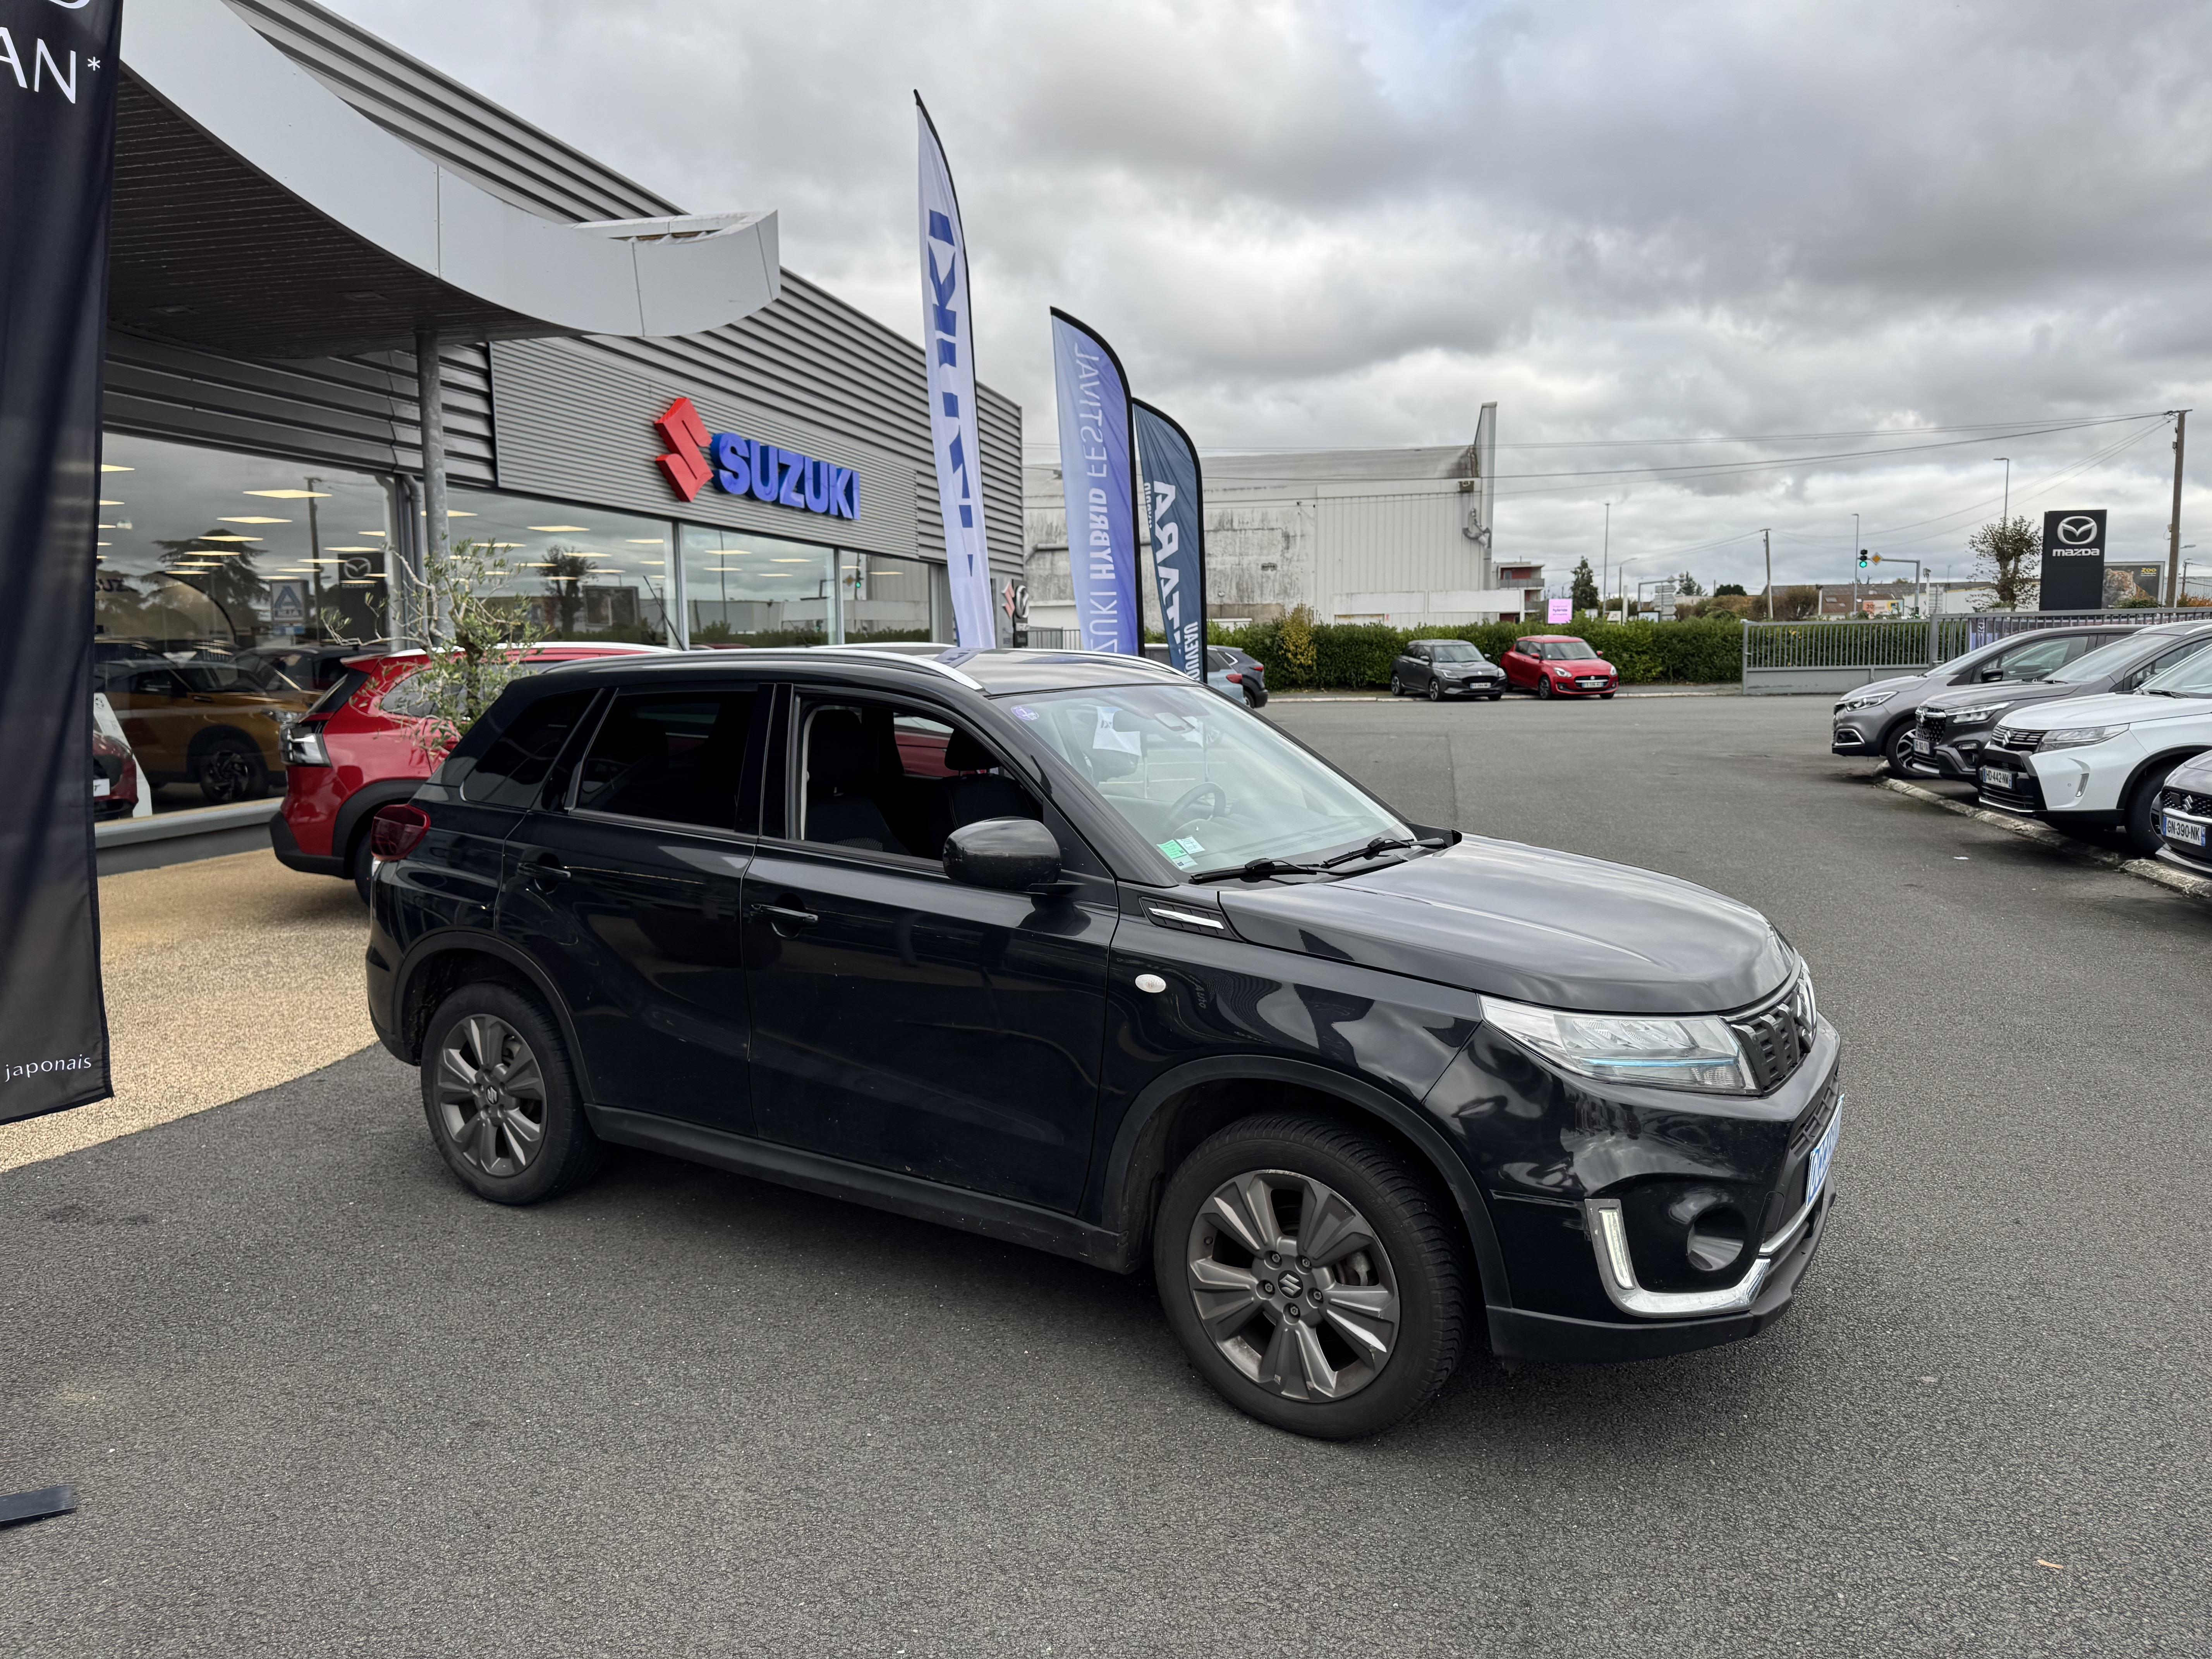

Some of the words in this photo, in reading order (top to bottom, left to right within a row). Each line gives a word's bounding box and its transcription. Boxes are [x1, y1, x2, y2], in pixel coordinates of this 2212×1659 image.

[710, 432, 860, 520] SUZUKI
[2052, 548, 2100, 556] mazda
[2167, 820, 2200, 841] GN-390-NK
[5, 1054, 91, 1082] japonais
